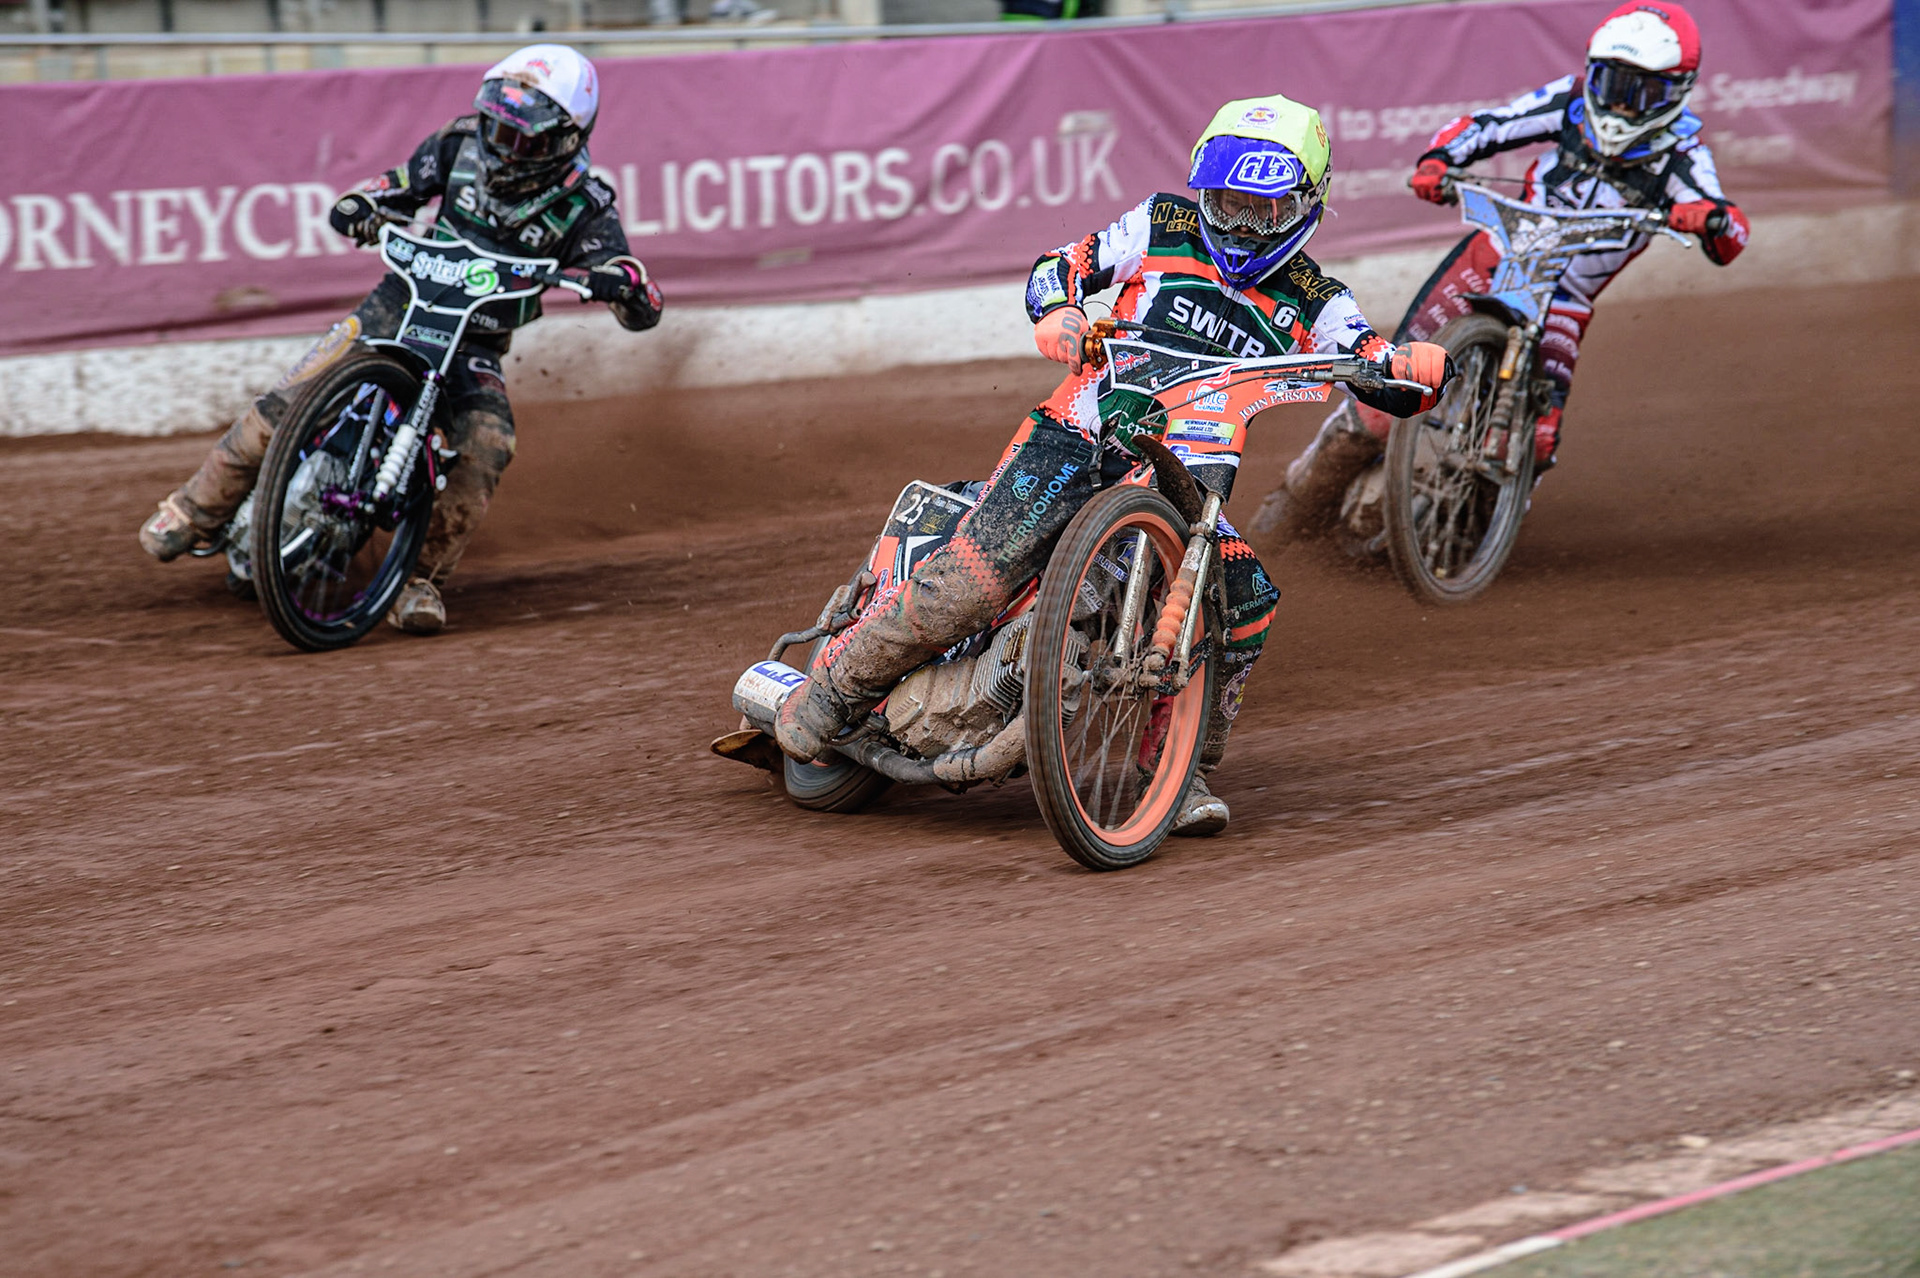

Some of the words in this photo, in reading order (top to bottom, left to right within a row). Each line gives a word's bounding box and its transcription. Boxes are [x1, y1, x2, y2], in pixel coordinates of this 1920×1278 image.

[1710, 66, 1858, 117] Speedway
[1273, 306, 1298, 329] 6
[1239, 399, 1268, 421] JOHN
[1270, 389, 1323, 404] PARSONS
[895, 493, 931, 525] 25
[999, 462, 1080, 562] THERMOHOME
